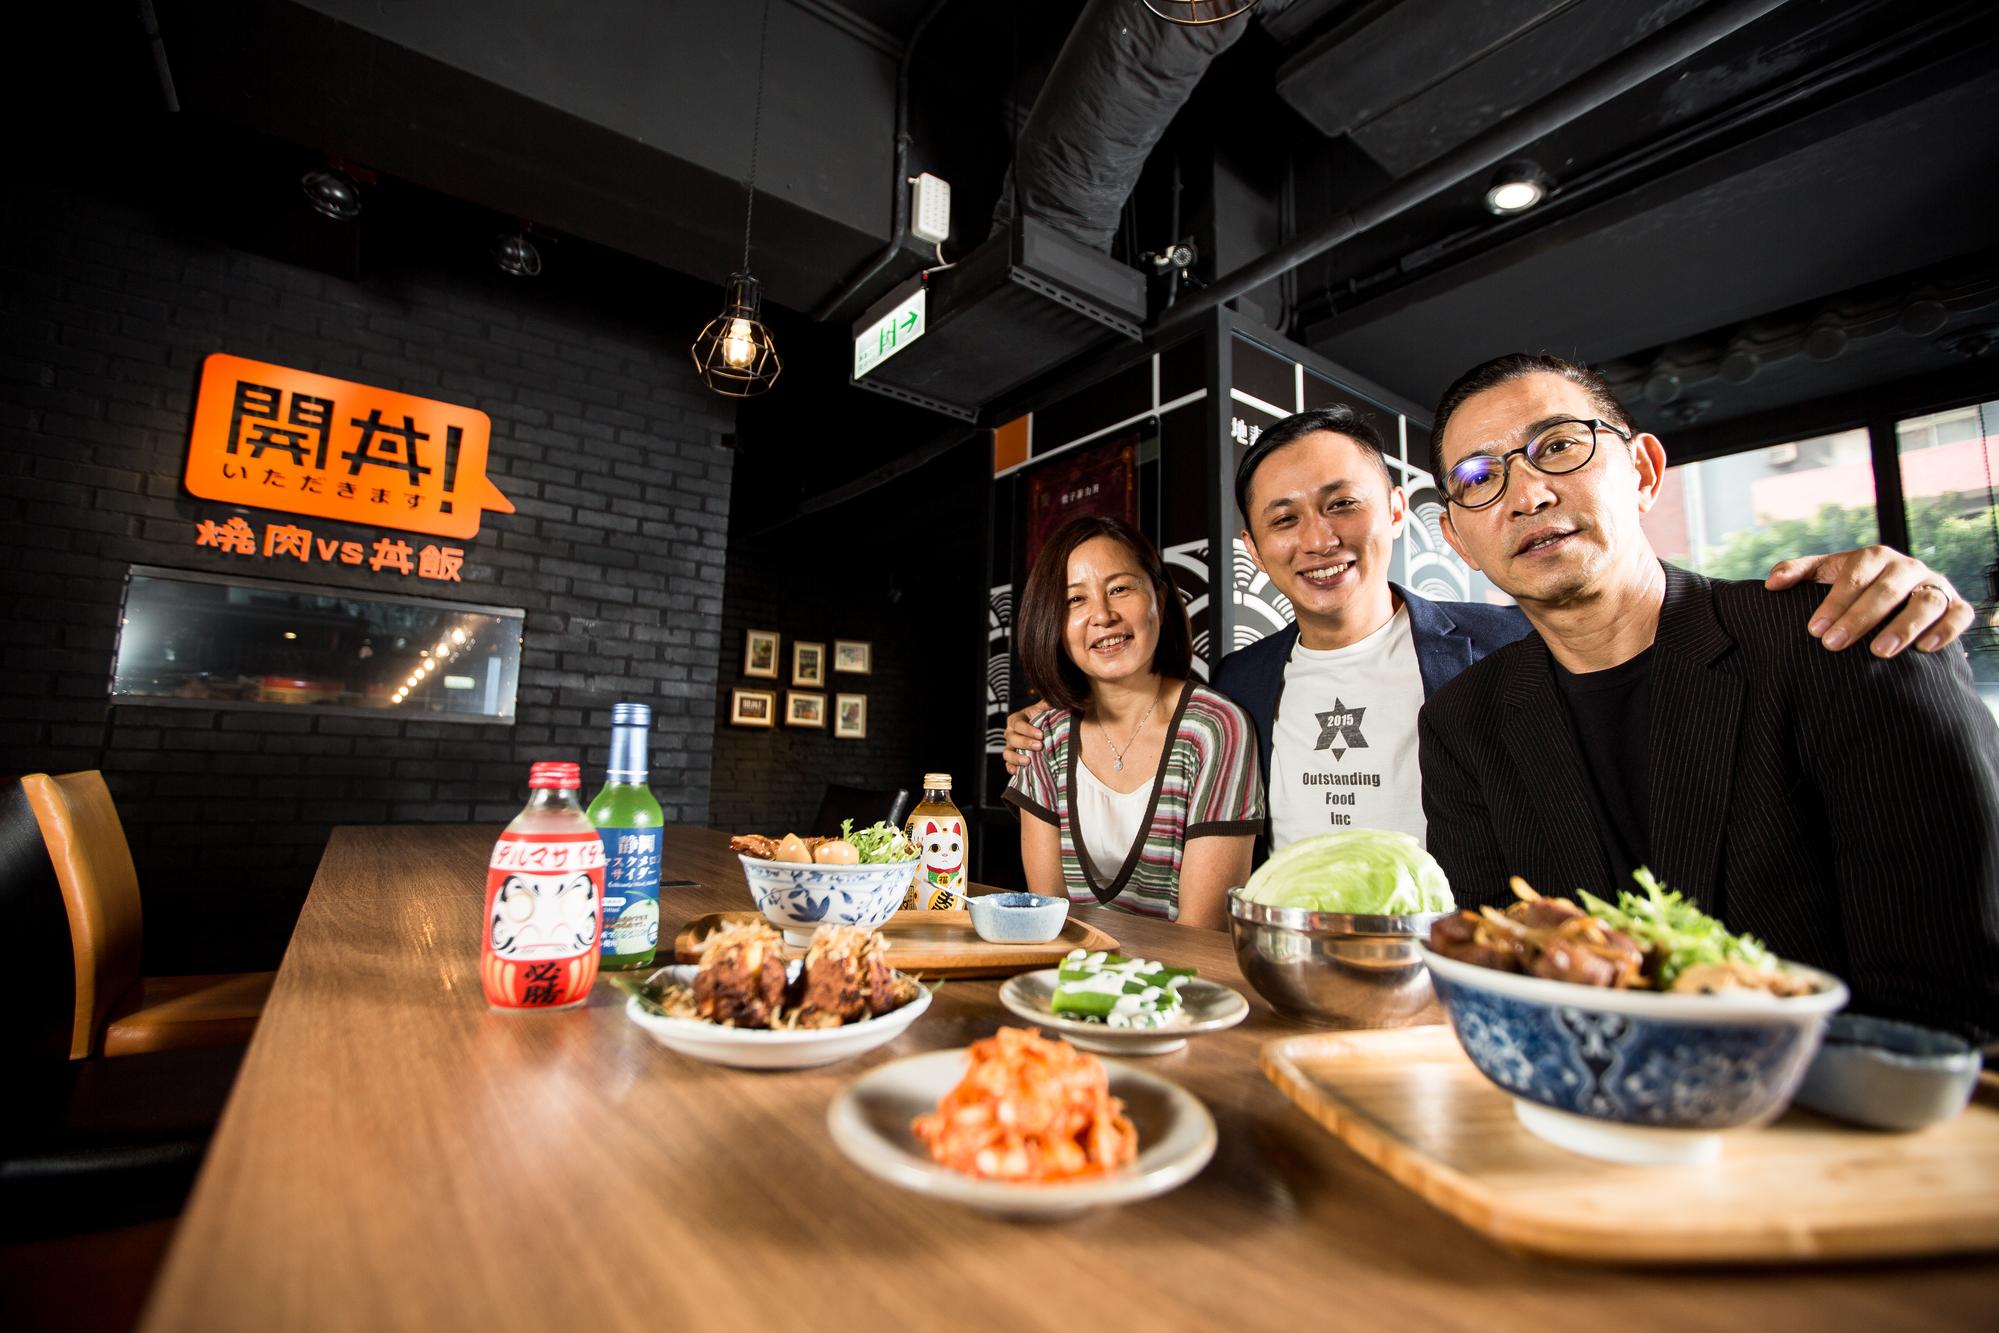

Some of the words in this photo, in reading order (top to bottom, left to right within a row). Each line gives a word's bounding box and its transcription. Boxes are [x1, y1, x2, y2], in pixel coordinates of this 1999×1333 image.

[226, 380, 463, 514] 開丼!
[222, 462, 426, 509] いただきます
[1327, 713, 1354, 727] 2015
[1302, 772, 1381, 787] Outstanding
[1325, 791, 1355, 805] Food
[1330, 812, 1351, 826] Inc
